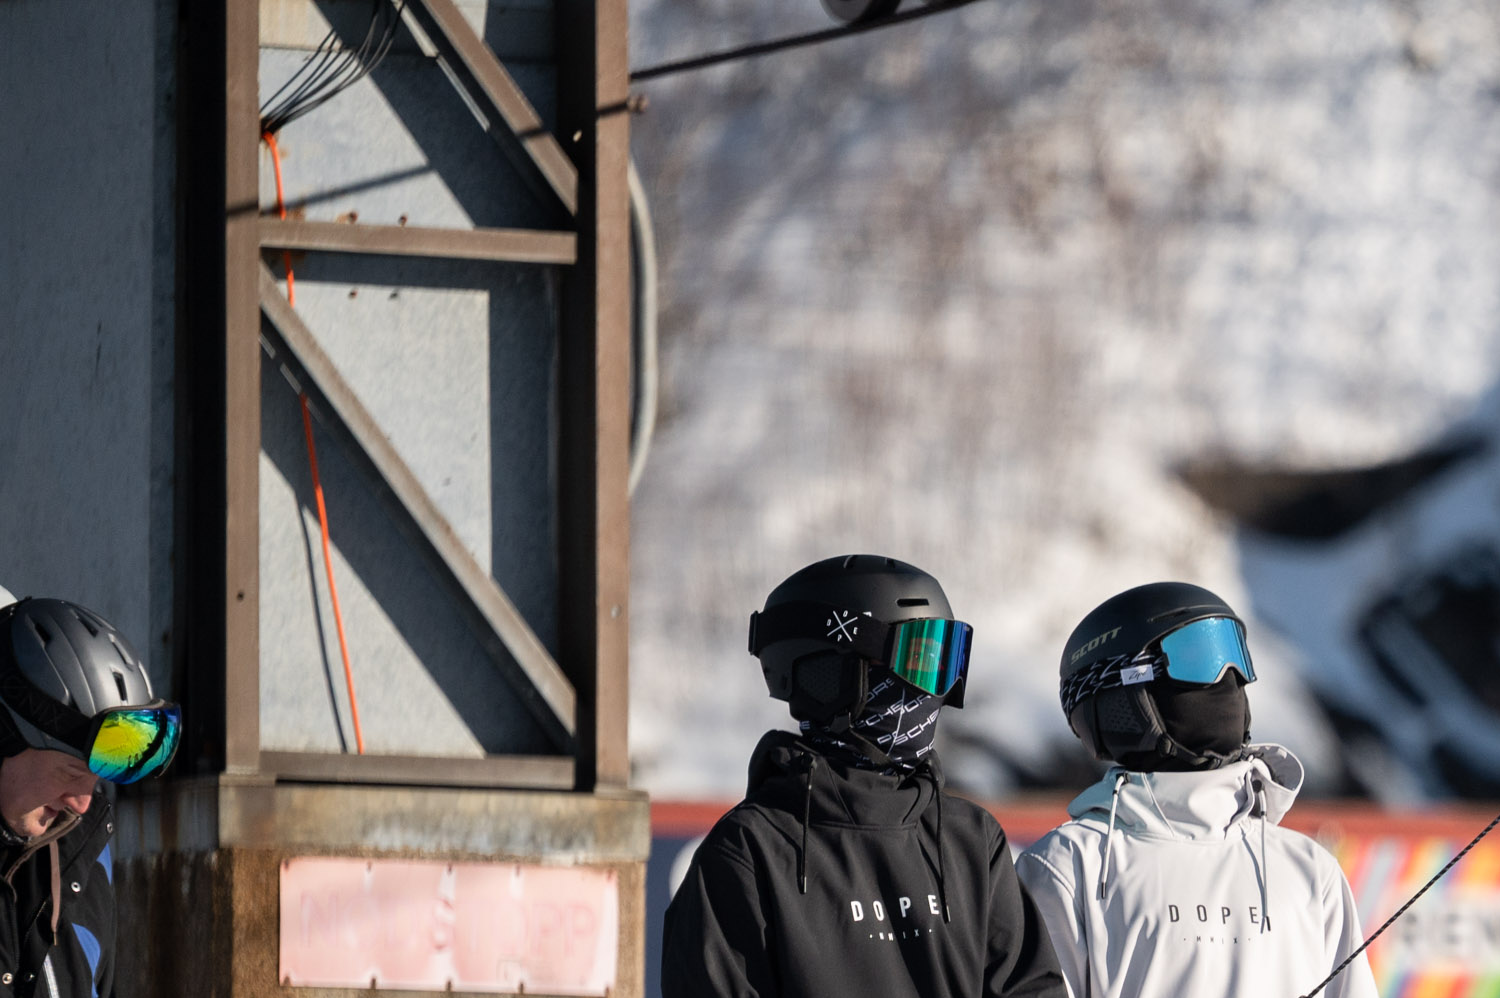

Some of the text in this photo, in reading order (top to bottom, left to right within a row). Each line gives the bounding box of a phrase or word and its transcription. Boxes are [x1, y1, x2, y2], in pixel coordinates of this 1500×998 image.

[1070, 626, 1122, 665] SCOTT
[850, 894, 940, 922] DOPE
[1168, 904, 1260, 925] DOPE
